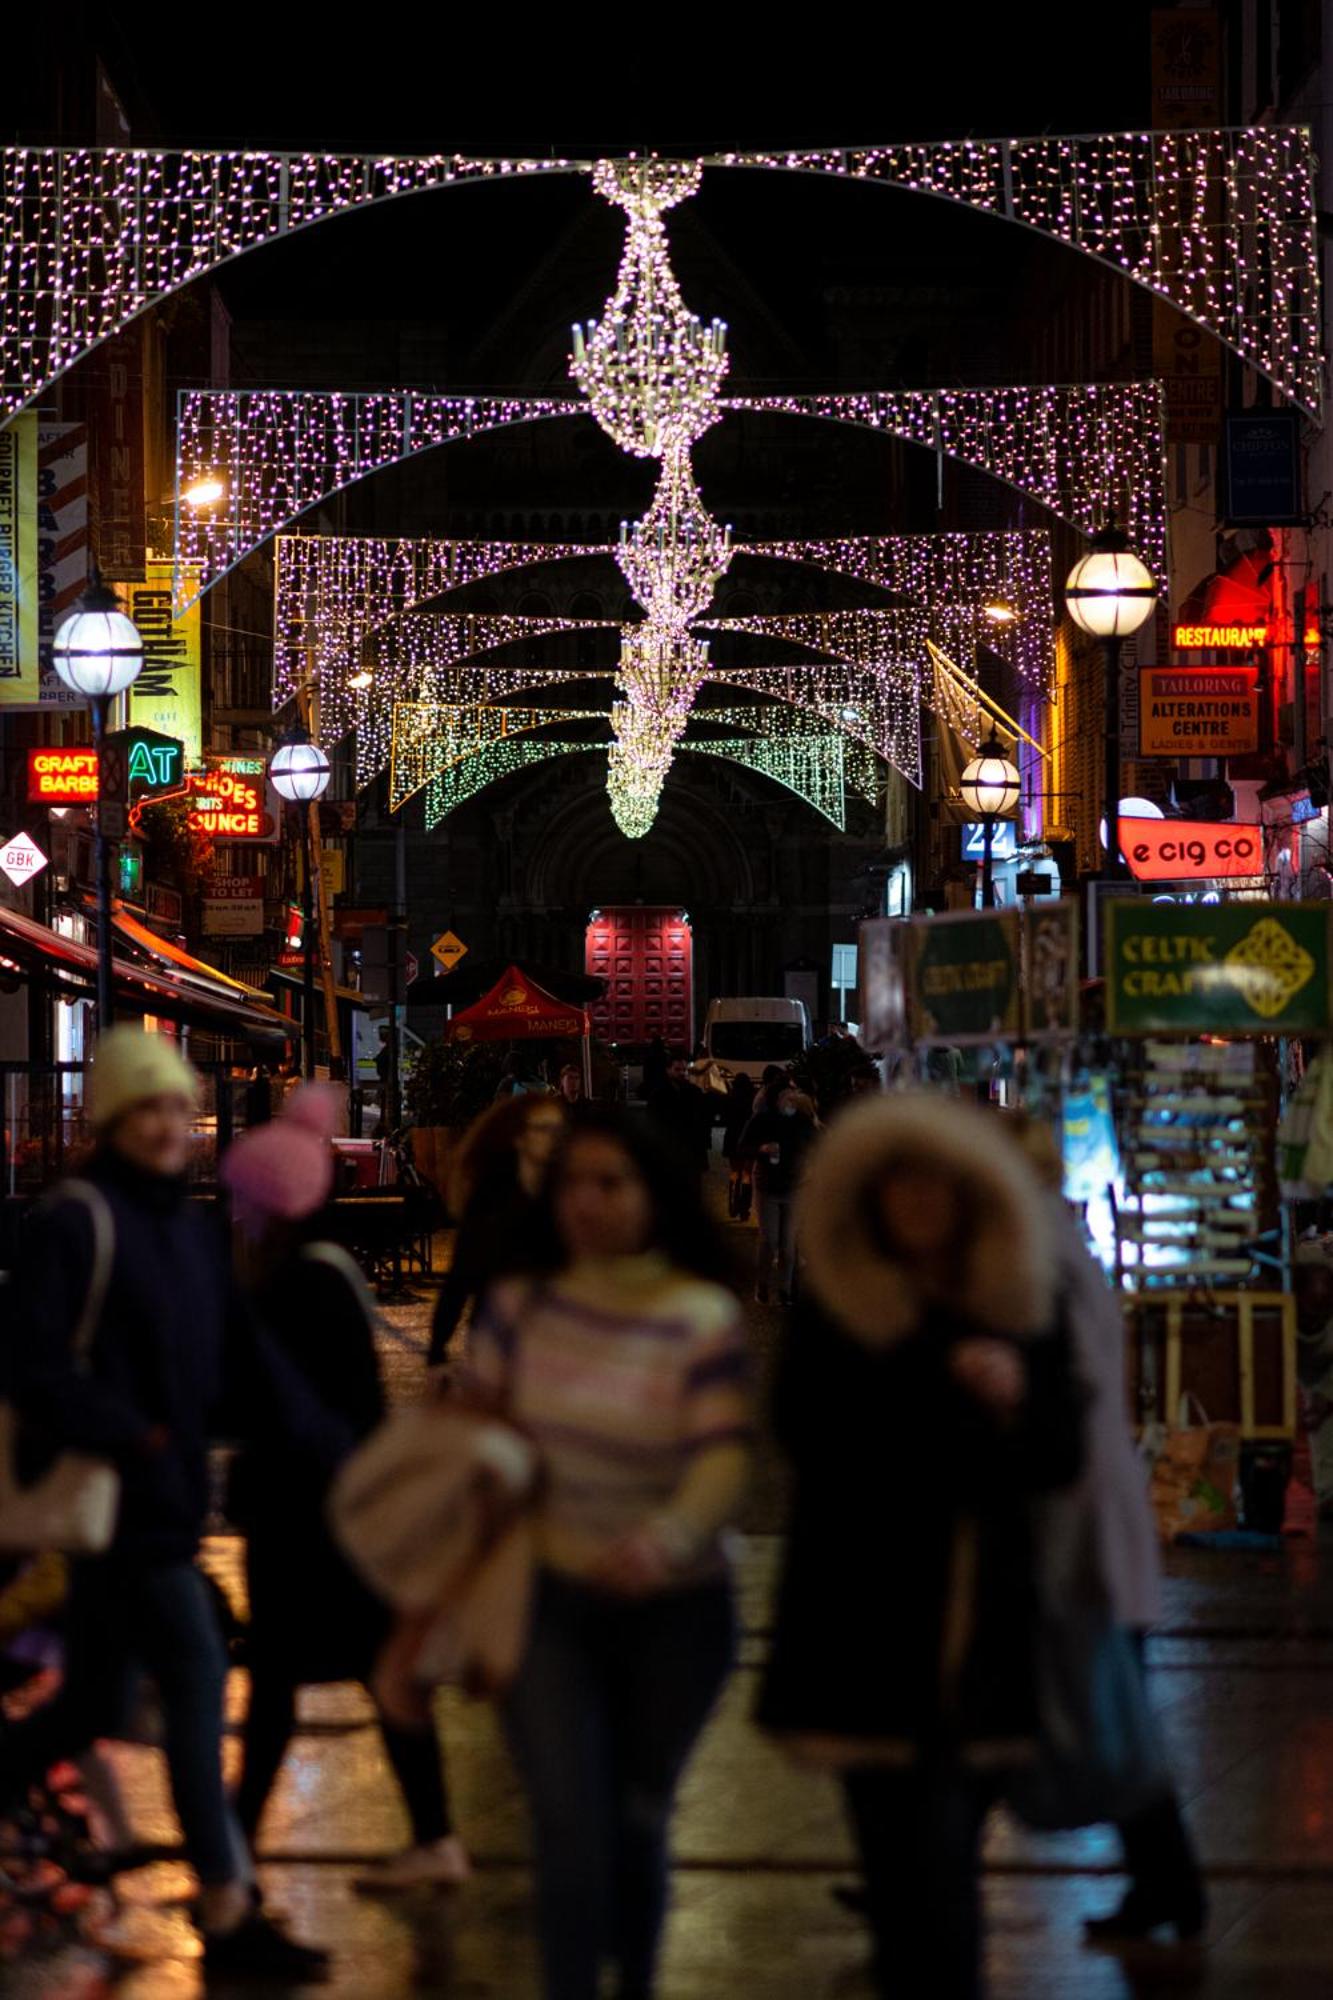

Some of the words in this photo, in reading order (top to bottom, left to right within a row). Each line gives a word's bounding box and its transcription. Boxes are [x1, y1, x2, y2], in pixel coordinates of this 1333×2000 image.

[0, 524, 13, 596] BURGER
[0, 601, 14, 675] KITCHEN
[132, 590, 195, 697] GOTHAM
[1160, 677, 1241, 694] TAILORING
[1151, 702, 1251, 718] ALTERATIONS
[1172, 720, 1230, 736] CENTRE
[966, 822, 1008, 851] 22
[6, 851, 35, 867] GBK
[214, 877, 251, 888] SHOP
[209, 888, 228, 897] TO
[231, 888, 255, 897] LET
[1121, 935, 1216, 963] CELTIC
